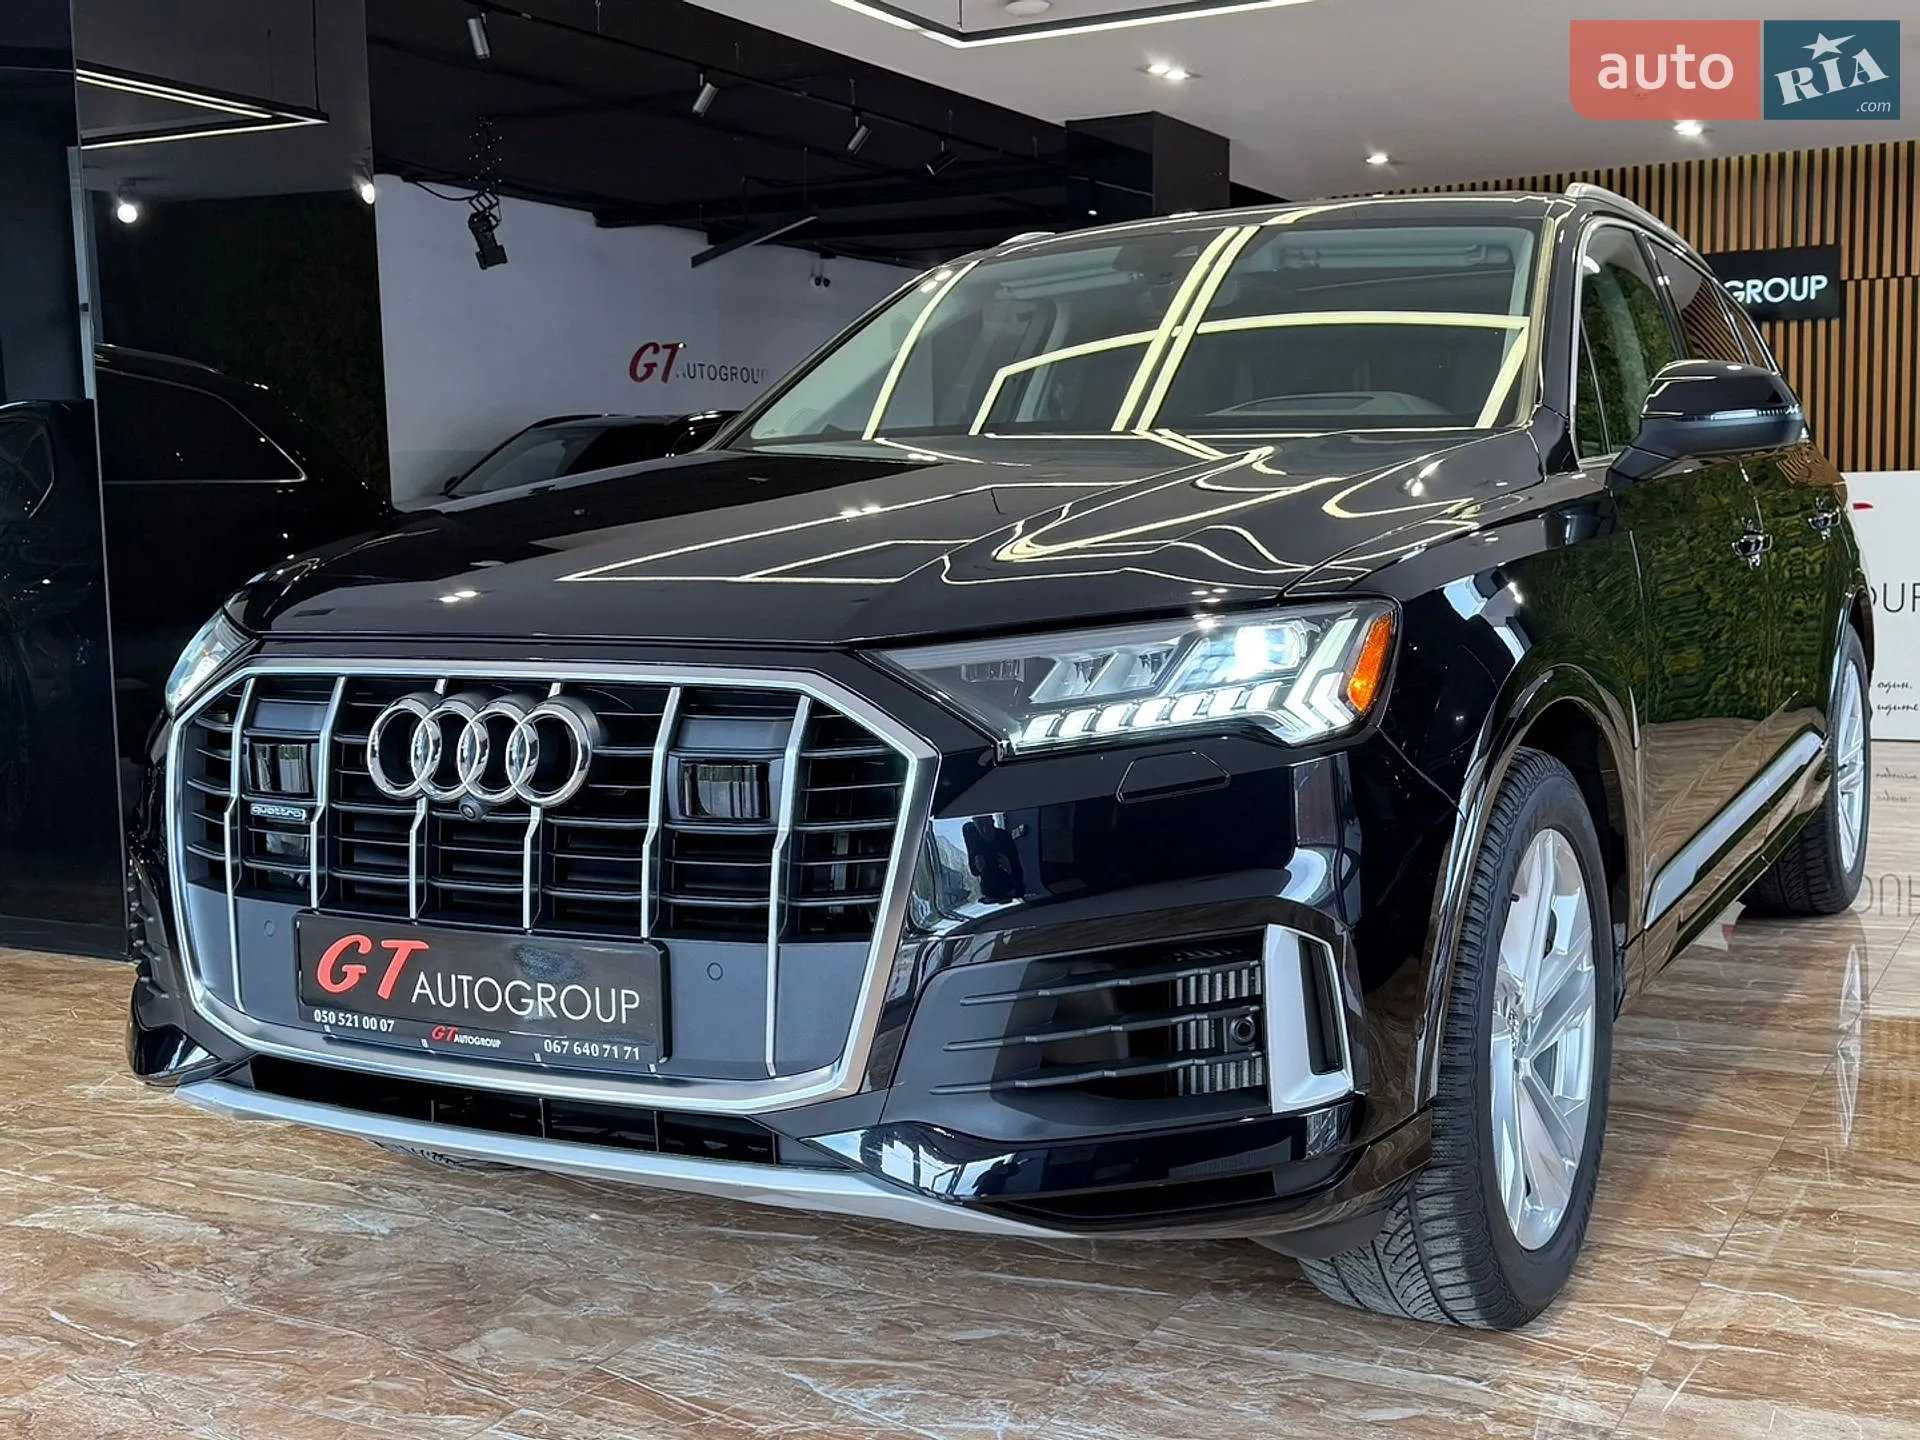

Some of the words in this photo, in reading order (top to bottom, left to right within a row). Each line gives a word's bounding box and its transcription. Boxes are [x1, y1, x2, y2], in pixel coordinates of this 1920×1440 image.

[629, 341, 688, 384] GT
[251, 805, 303, 818] quattro
[316, 933, 431, 1001] GT
[411, 971, 641, 1024] AUTOGROUP
[313, 1009, 336, 1024] 050
[338, 1012, 359, 1028] 521
[362, 1016, 378, 1030] 00
[379, 1018, 395, 1032] 07
[431, 1024, 459, 1042] GT
[453, 1033, 502, 1049] AUTOGROUP
[543, 1038, 570, 1054] 067
[573, 1041, 600, 1057] 640
[602, 1044, 619, 1059] 71
[623, 1046, 640, 1061] 71
